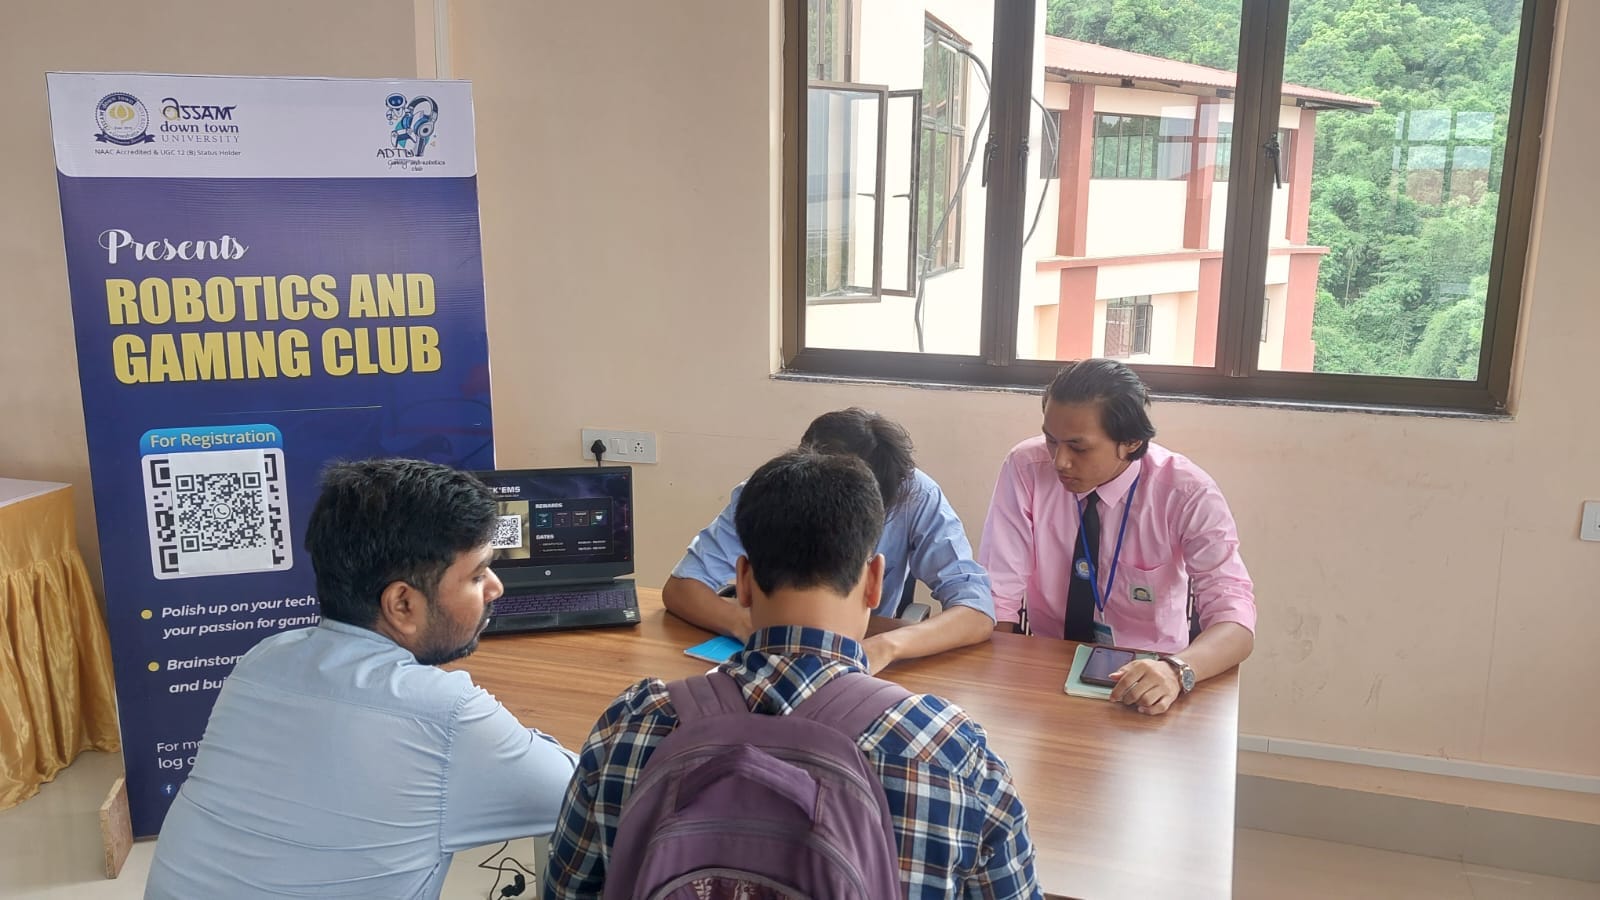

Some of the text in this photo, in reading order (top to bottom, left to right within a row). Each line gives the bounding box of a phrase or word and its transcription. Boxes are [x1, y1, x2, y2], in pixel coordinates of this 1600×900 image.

[160, 120, 239, 133] down town
[161, 134, 240, 143] UNIVERSITY
[98, 229, 249, 264] Presents
[105, 273, 436, 325] ROBOTICS AND
[112, 325, 442, 385] GAMING CLUB
[150, 429, 276, 449] For Registration
[162, 594, 316, 618] Polish up on your tech
[162, 612, 322, 640] your passion for gamin
[169, 680, 200, 693] and
[157, 742, 180, 753] For
[158, 757, 183, 770] log
